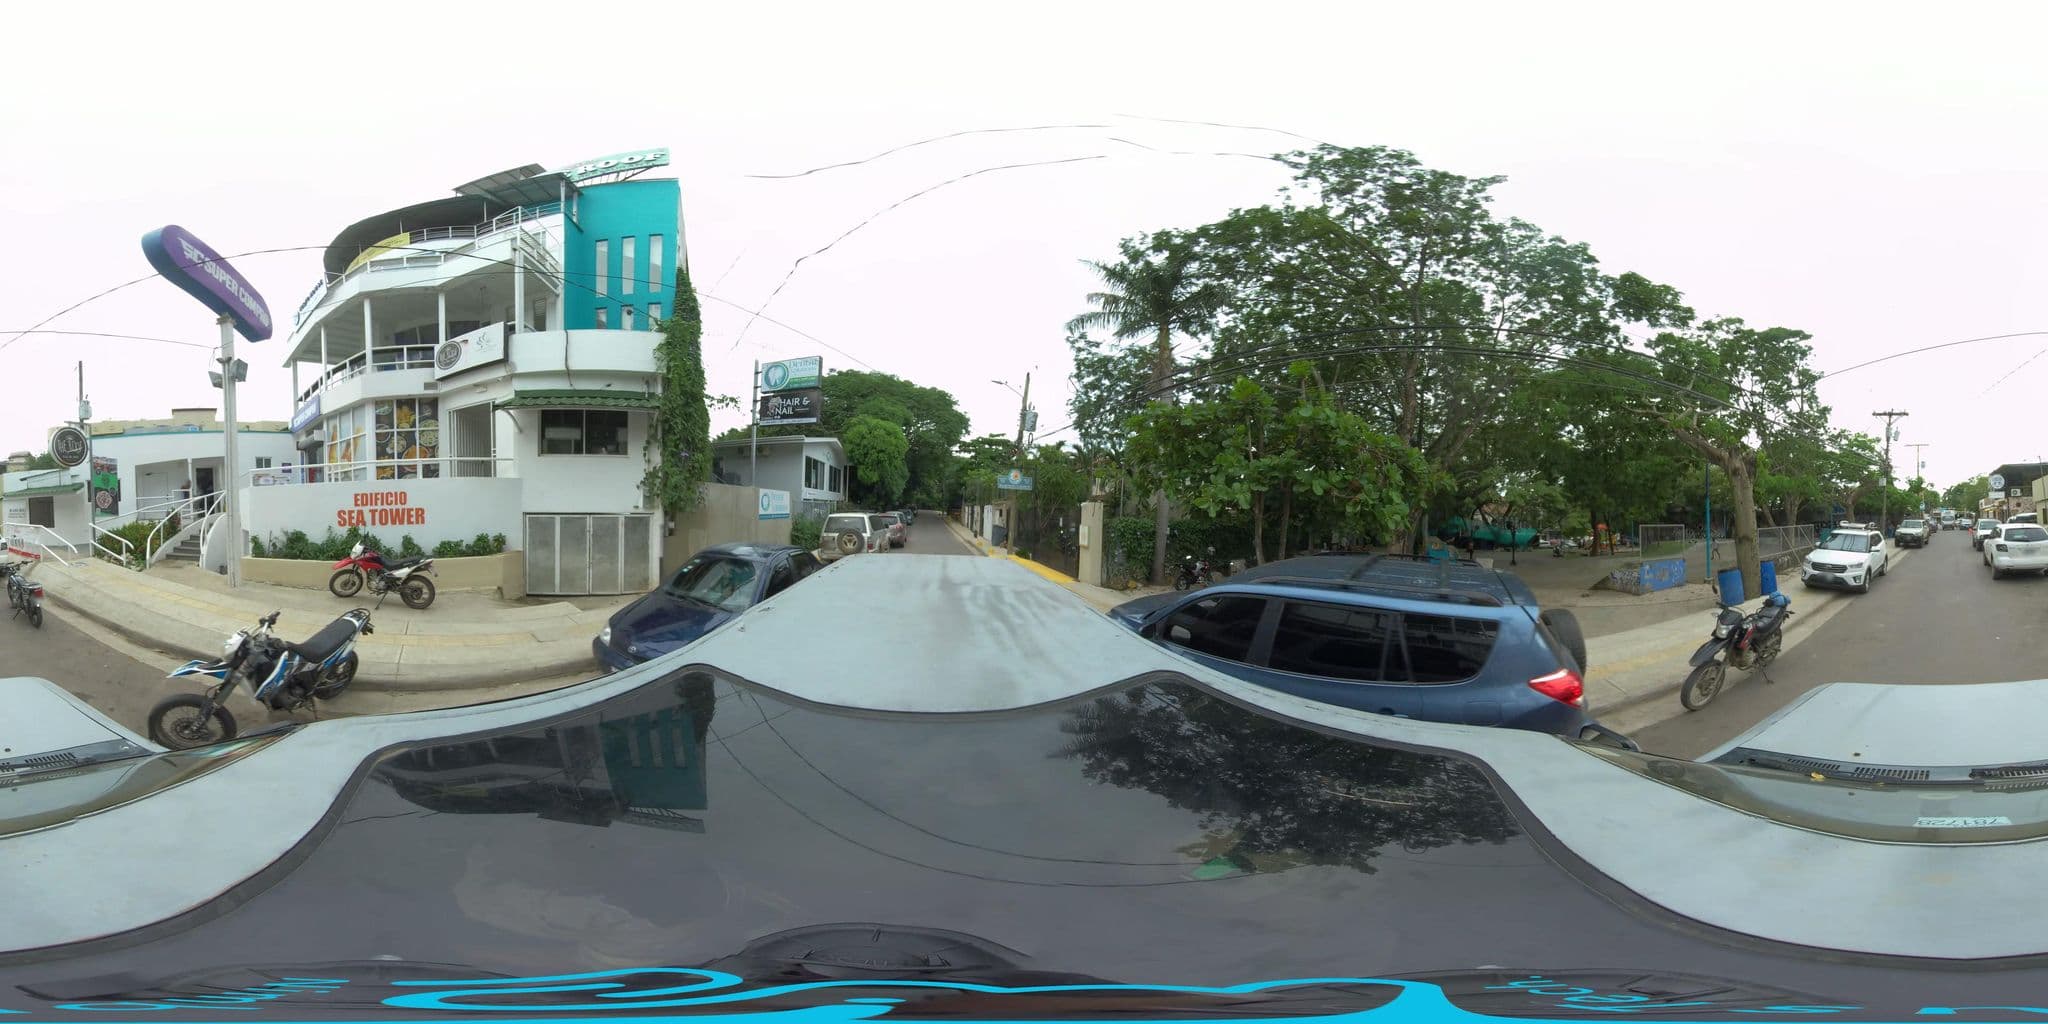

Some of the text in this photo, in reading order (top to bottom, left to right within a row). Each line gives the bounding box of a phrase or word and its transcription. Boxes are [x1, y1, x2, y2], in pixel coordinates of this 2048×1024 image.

[203, 256, 239, 297] SUPER
[780, 396, 811, 406] HAIR &
[775, 405, 794, 415] NAIL
[353, 490, 408, 507] EDIFICIO
[336, 506, 426, 528] SEA TOWER
